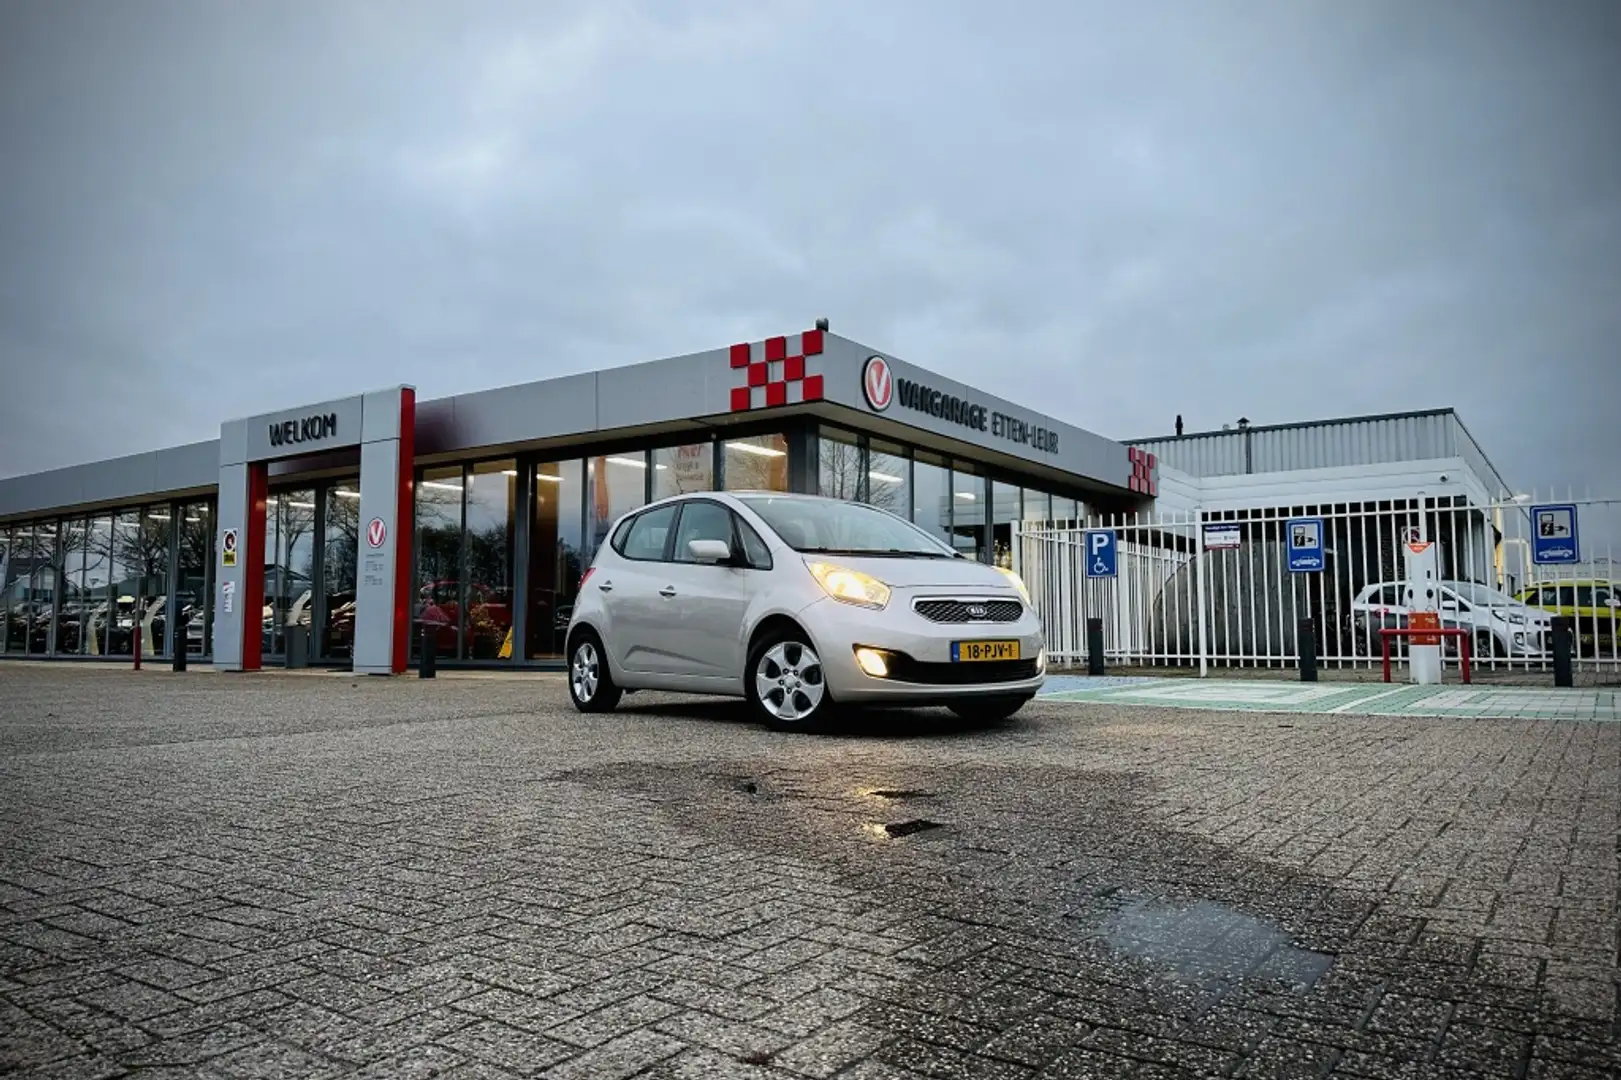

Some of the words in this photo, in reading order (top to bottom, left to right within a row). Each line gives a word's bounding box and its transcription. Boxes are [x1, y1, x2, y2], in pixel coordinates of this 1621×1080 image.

[268, 412, 337, 447] WELKOM
[897, 378, 988, 432] VAKGARAGE
[991, 411, 1059, 454] ETTEN-LEUR
[1092, 533, 1109, 556] P
[966, 643, 1013, 660] 18-PJV-1
